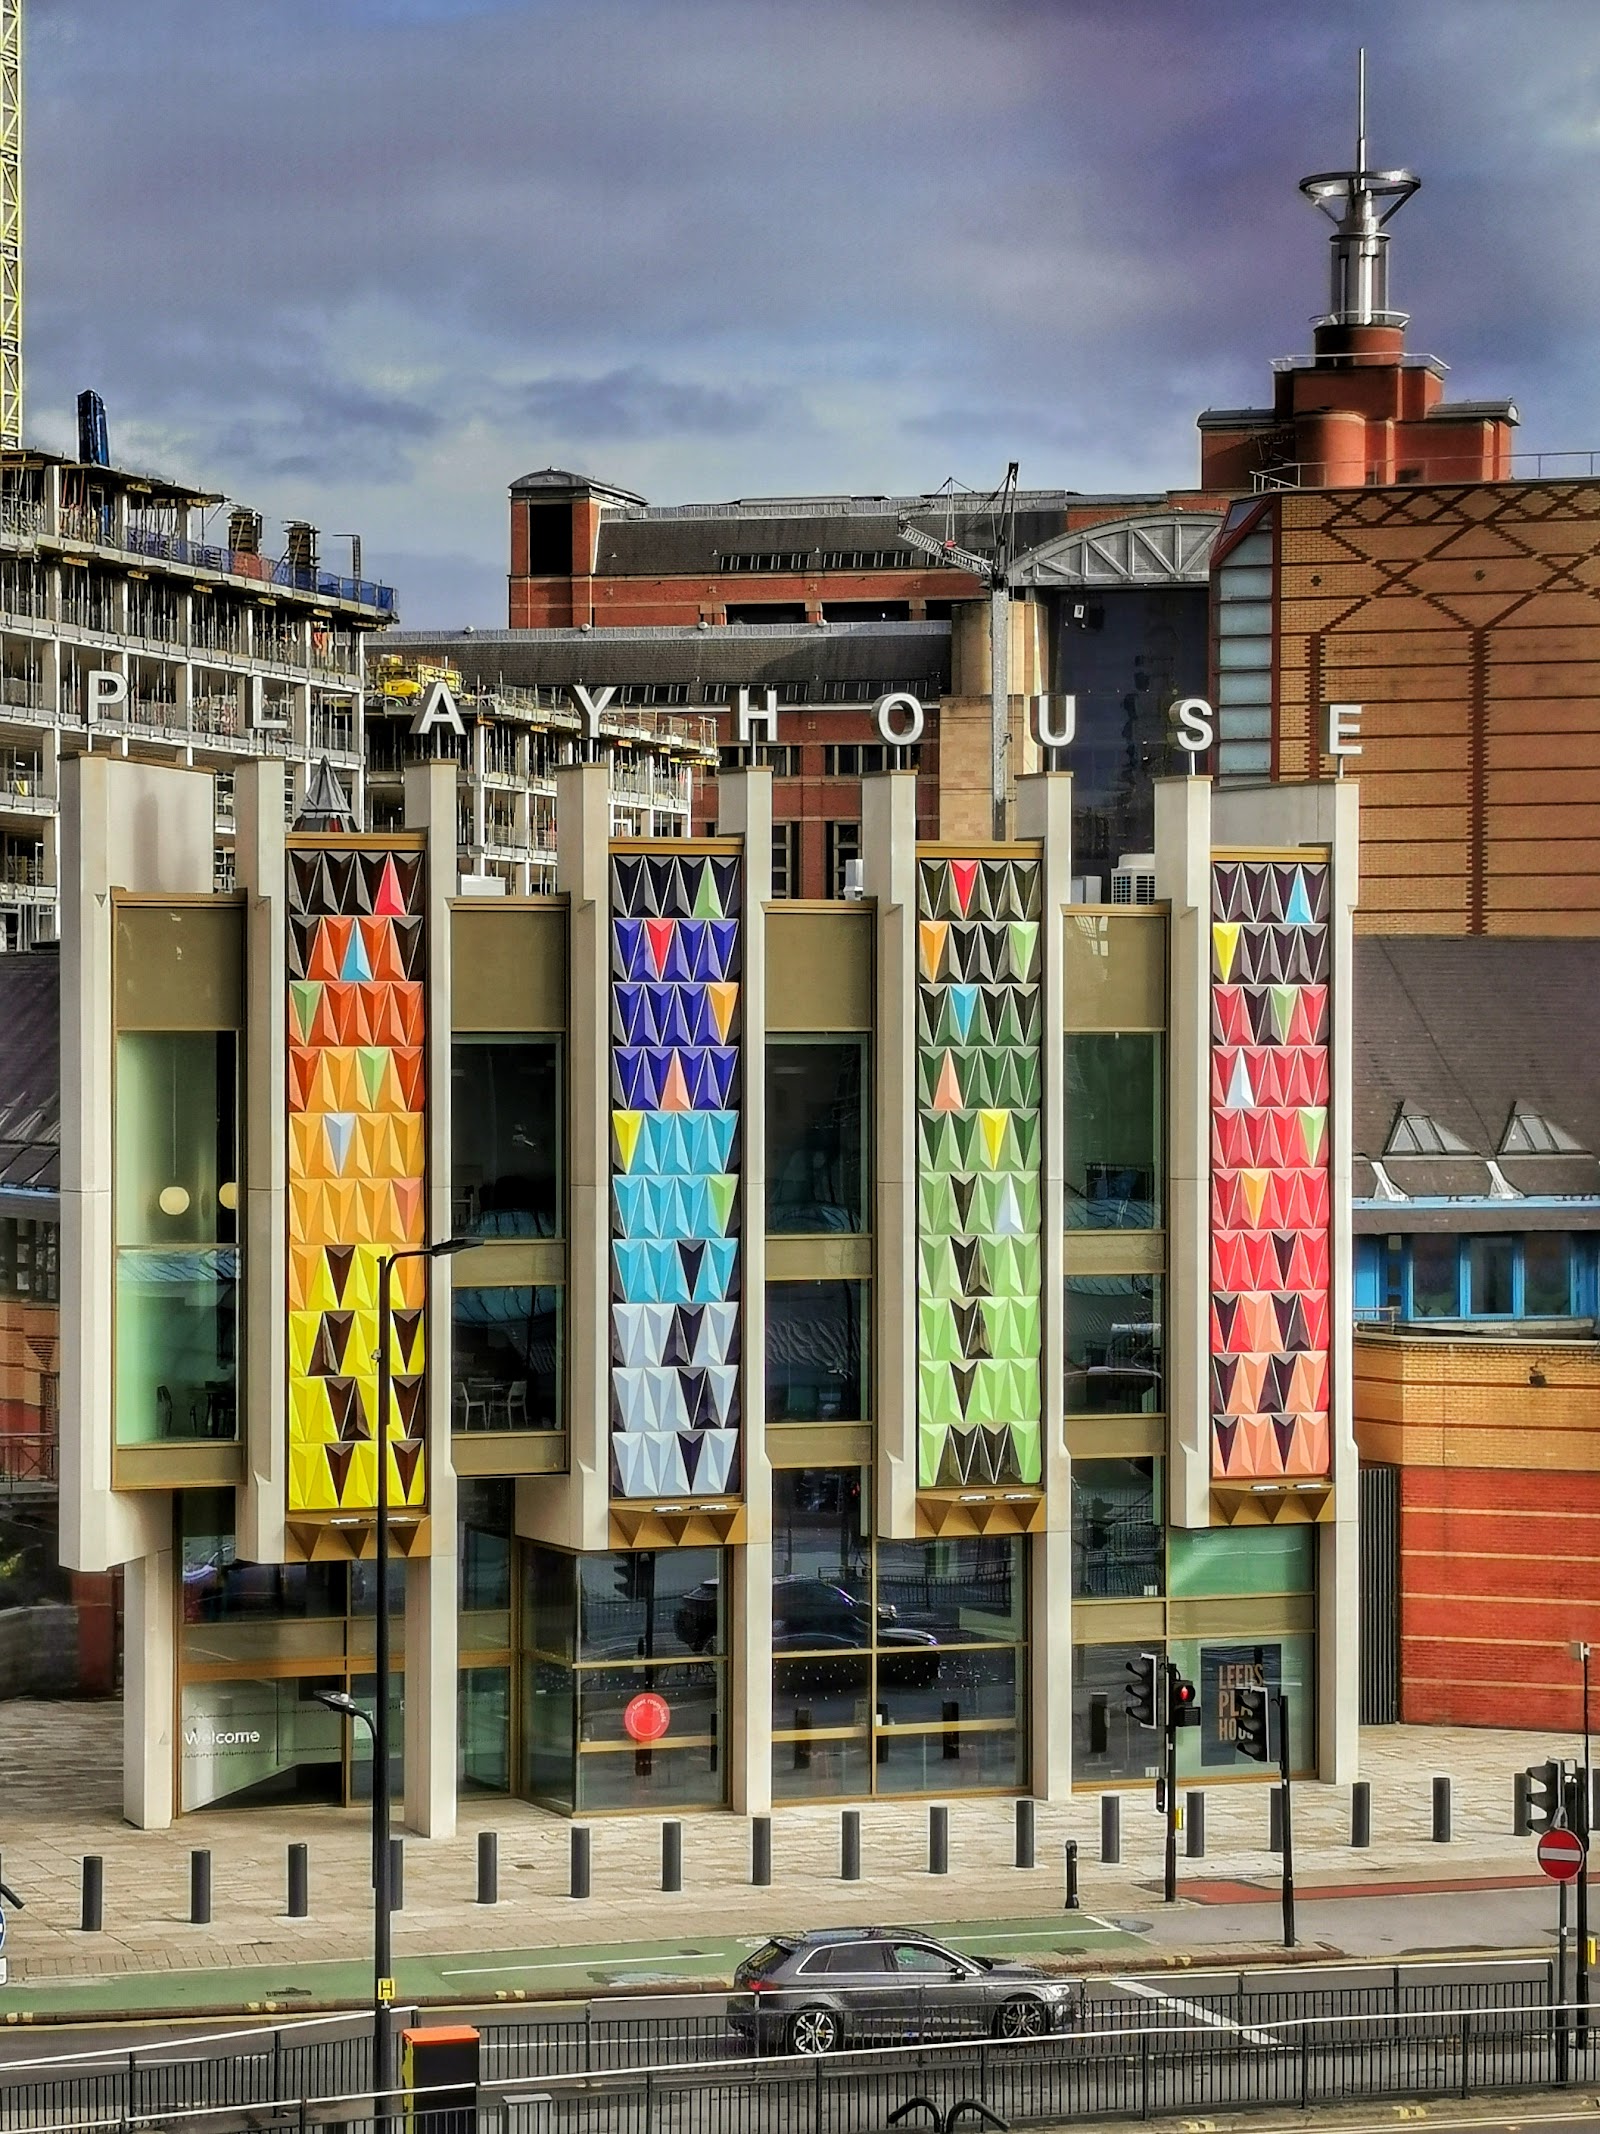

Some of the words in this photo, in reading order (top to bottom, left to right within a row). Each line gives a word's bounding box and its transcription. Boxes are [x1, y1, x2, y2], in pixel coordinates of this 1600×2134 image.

[1219, 1664, 1263, 1689] LEEDS
[185, 1729, 260, 1745] Wlcome
[381, 1979, 393, 1998] H
